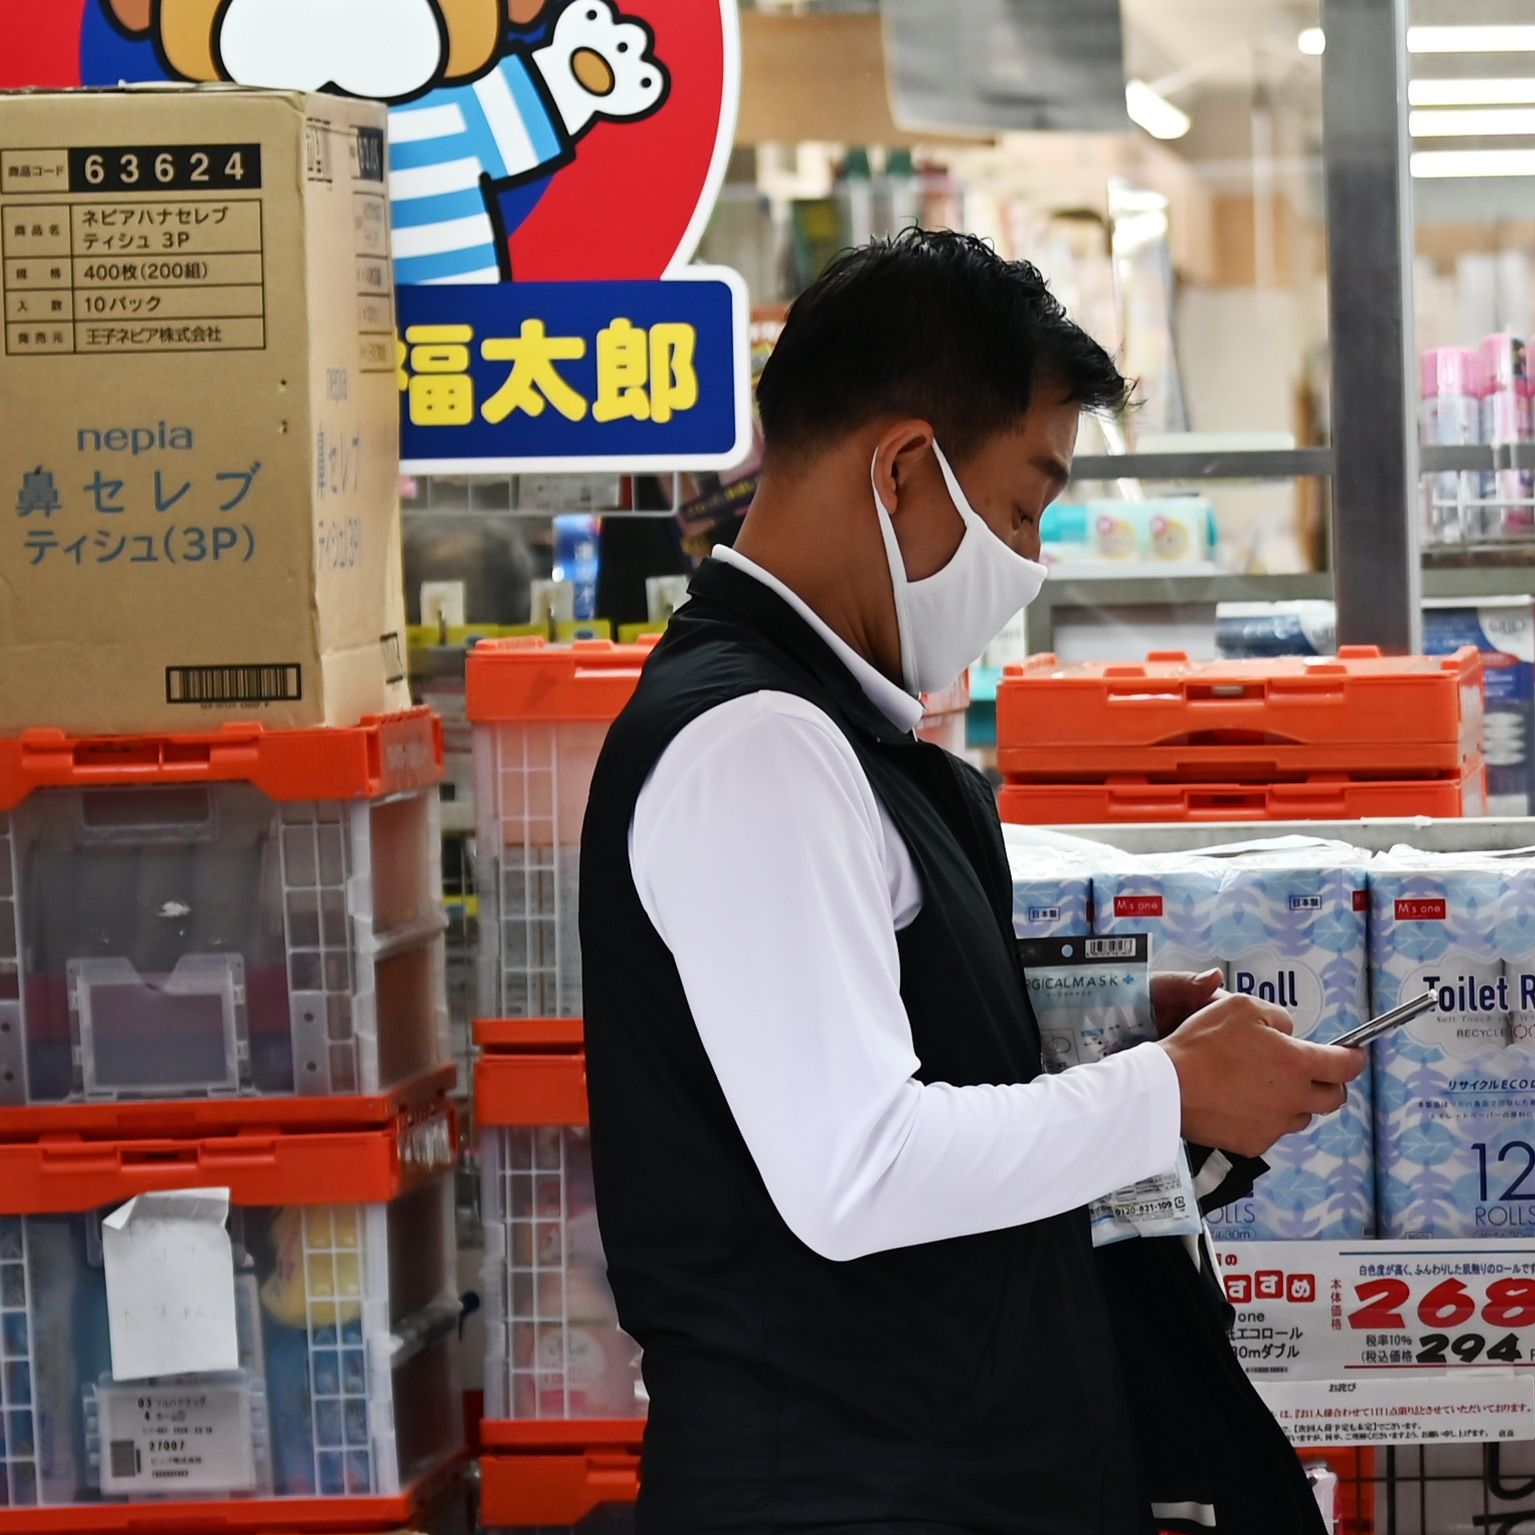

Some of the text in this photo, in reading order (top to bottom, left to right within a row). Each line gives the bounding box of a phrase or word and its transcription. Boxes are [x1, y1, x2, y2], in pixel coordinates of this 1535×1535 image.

[8, 166, 63, 177] 商品コード
[84, 152, 244, 184] 63624
[82, 207, 229, 226] ネピアハナセレブ
[83, 232, 190, 250] ティシュ 3P
[85, 296, 161, 313] 10パック
[399, 317, 699, 426] 福太郎
[77, 421, 193, 455] nepia
[16, 461, 262, 517] 鼻セレブ
[25, 525, 255, 566] ティシュ(3P)
[1138, 902, 1158, 911] one
[1292, 896, 1319, 908] 日本製
[1398, 903, 1440, 913] M's one
[1423, 975, 1508, 1012] Toilet
[1330, 1279, 1343, 1331] 本体価格
[1238, 1312, 1265, 1323] one
[1366, 1335, 1412, 1347] 税率10%
[1416, 1332, 1522, 1363] 294
